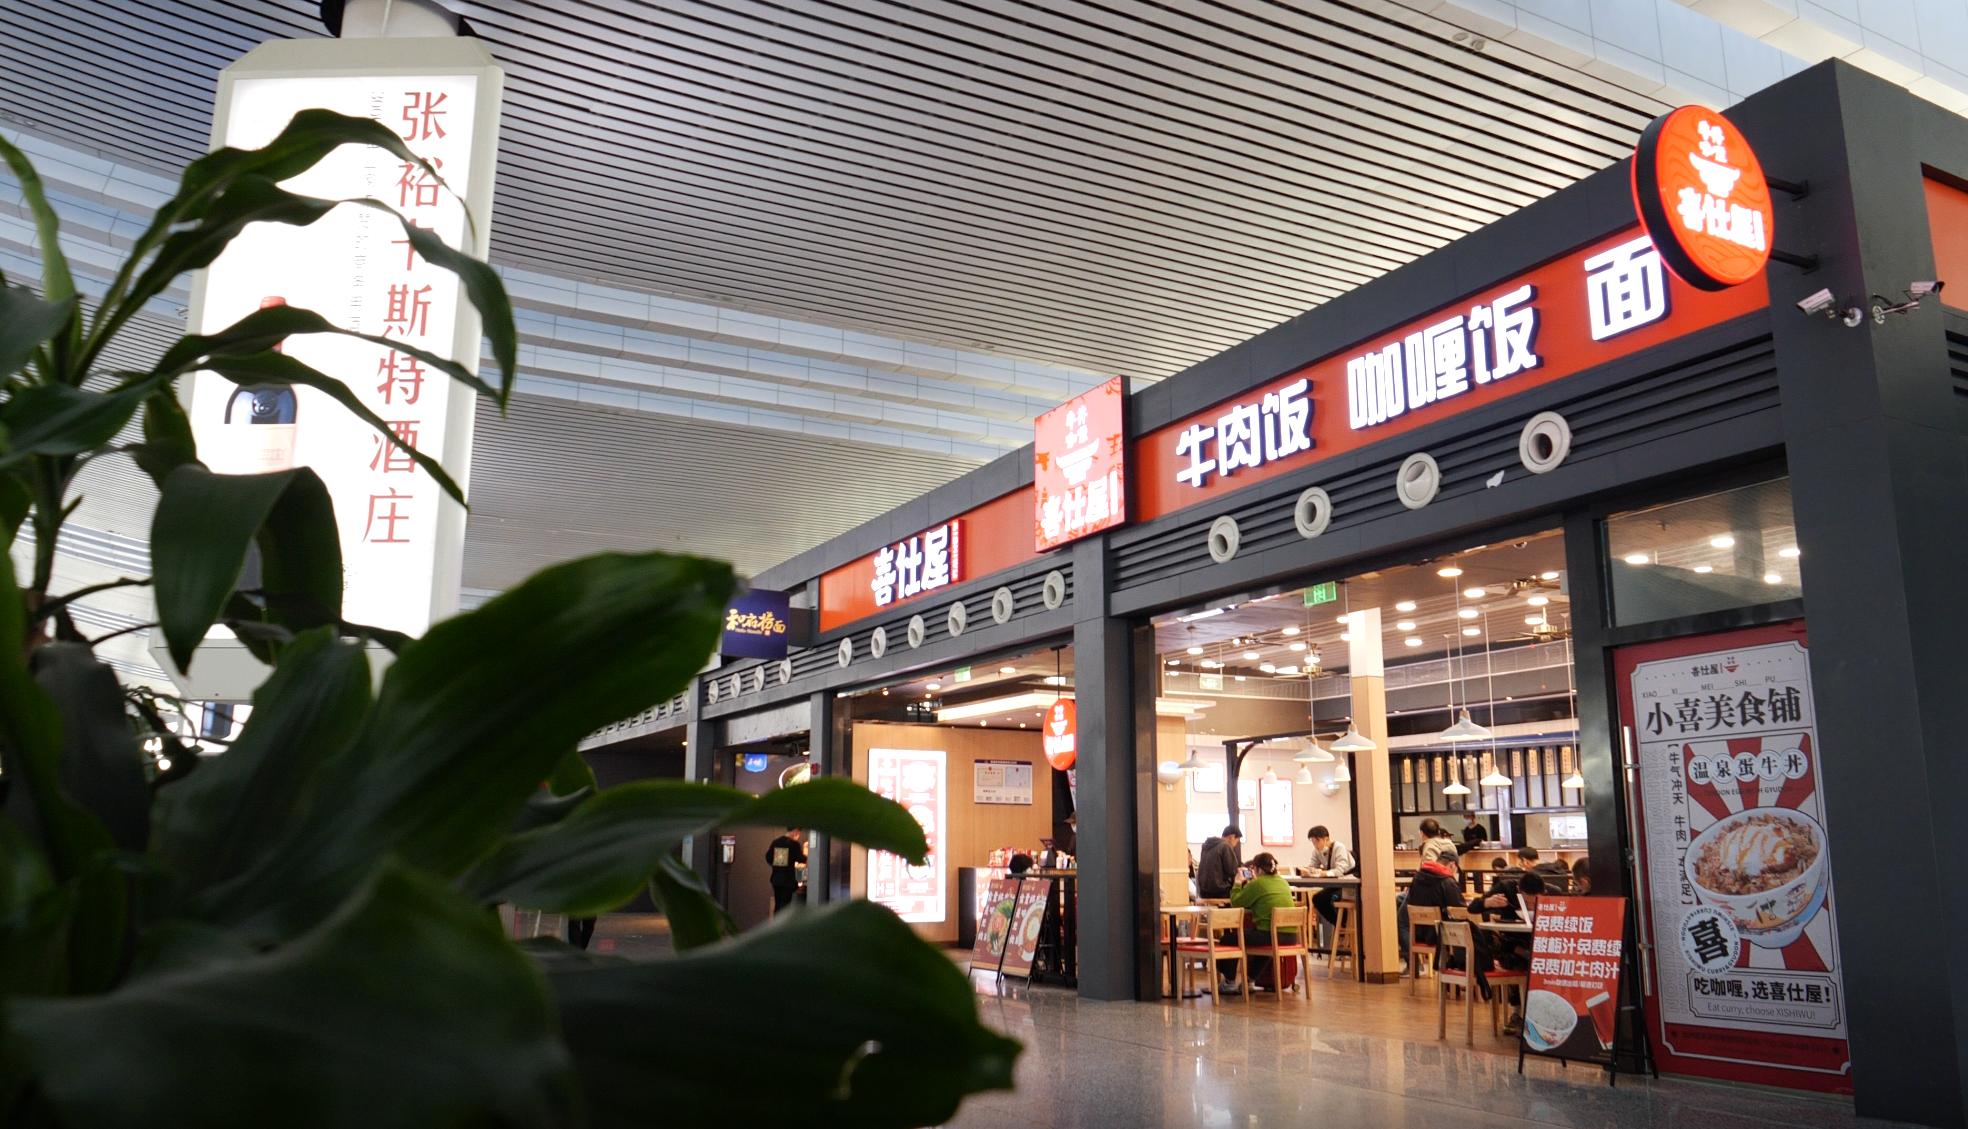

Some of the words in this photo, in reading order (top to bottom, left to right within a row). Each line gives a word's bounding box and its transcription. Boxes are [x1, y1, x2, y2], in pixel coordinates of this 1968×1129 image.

[1176, 379, 1313, 488] 牛肉饭
[1346, 284, 1538, 430] 咖喱饭
[1584, 236, 1669, 341] 面
[871, 524, 952, 607] 喜仕屋
[1646, 686, 1802, 736] 小喜美食铺
[1535, 914, 1593, 933] 免费续饭
[1531, 956, 1619, 979] 免费加牛肉汁
[1693, 977, 1832, 1004] 吃咖喱,选喜仕屋!
[1707, 1003, 1721, 1012] Eat
[1745, 1007, 1775, 1017] choose
